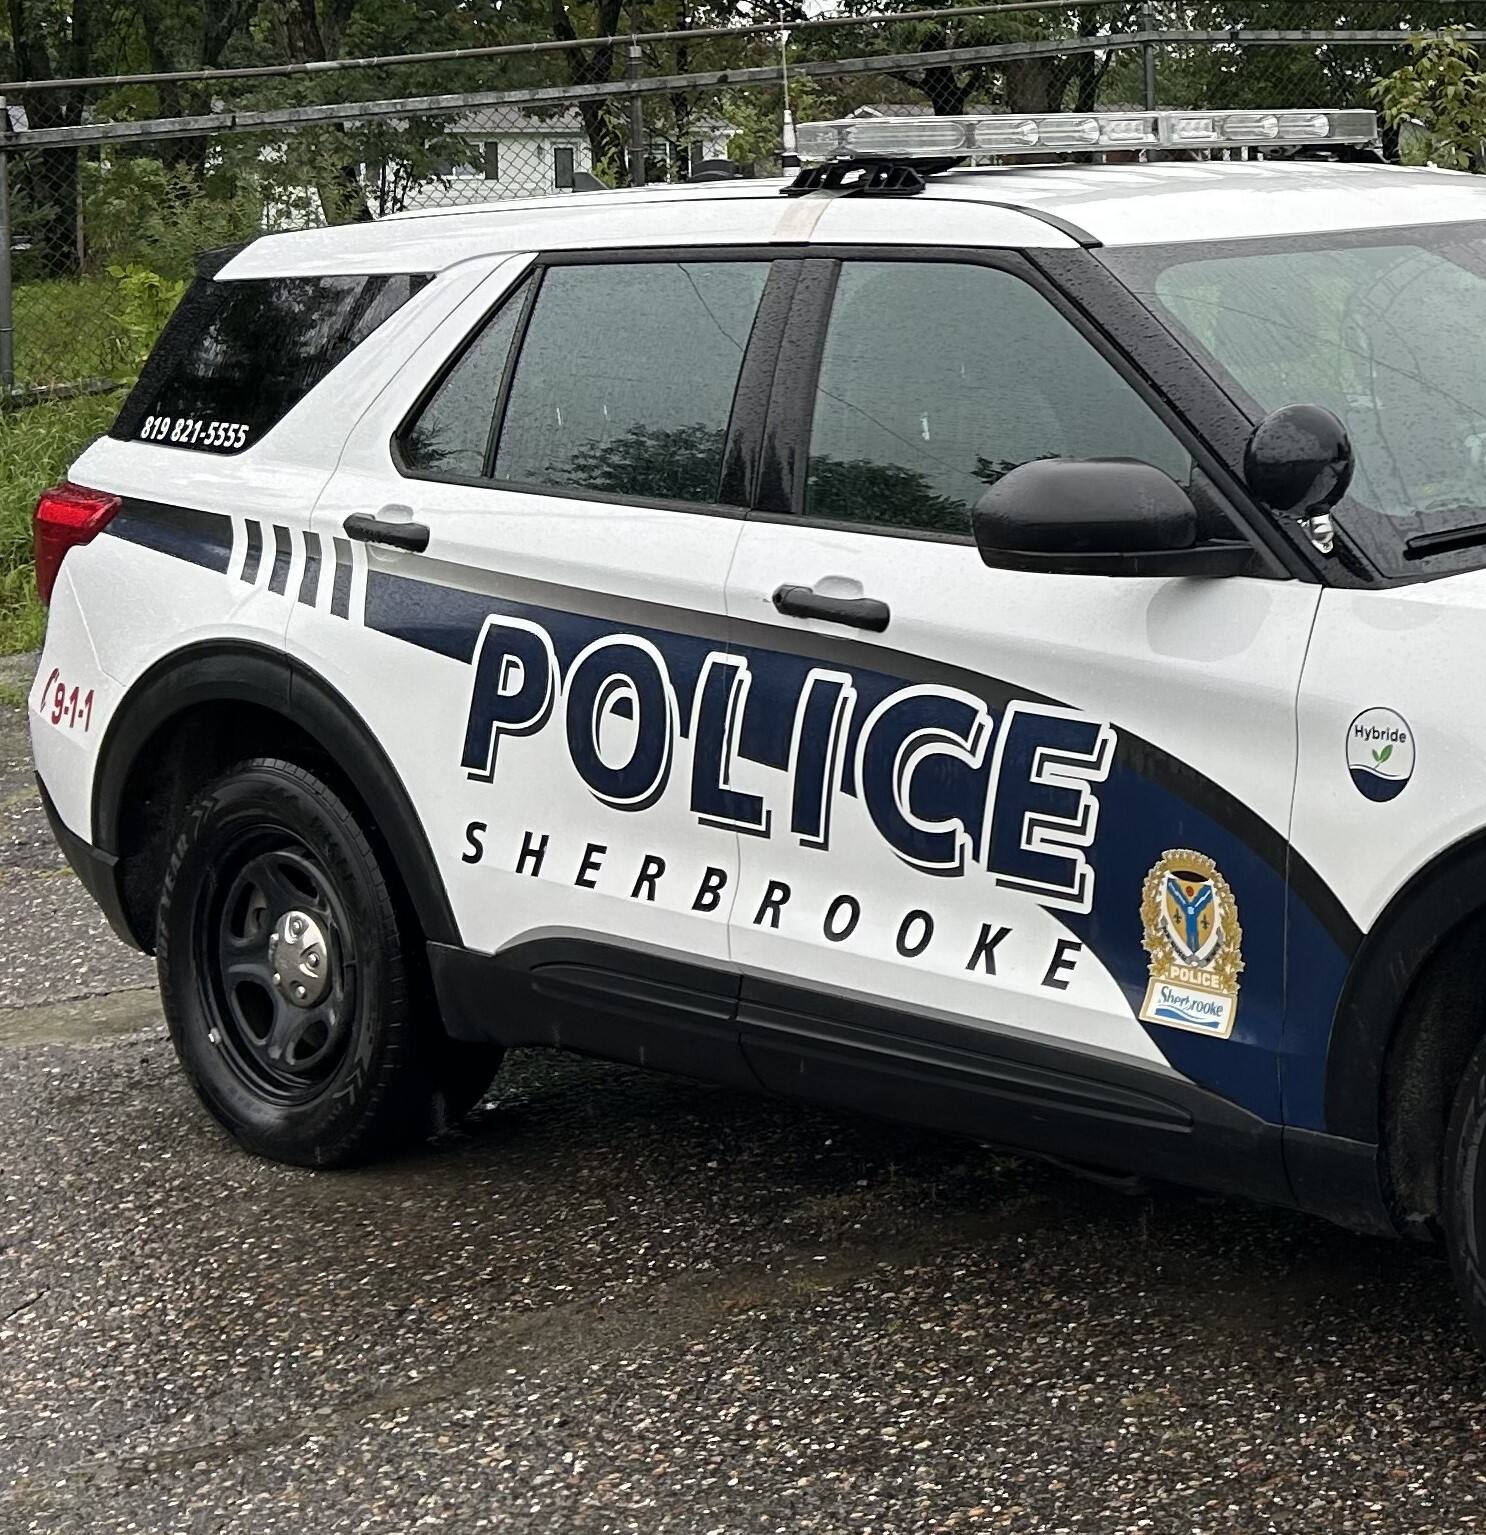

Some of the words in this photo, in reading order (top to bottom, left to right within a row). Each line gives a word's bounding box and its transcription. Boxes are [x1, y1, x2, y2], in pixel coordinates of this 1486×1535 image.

[140, 415, 171, 440] 819
[170, 418, 250, 448] 821-5555
[51, 682, 95, 733] 9-1-1
[1354, 724, 1407, 743] Hybride
[460, 613, 1118, 915] POLICE
[461, 820, 1083, 991] SHERBROOKE
[1169, 965, 1221, 989] POLICE
[1160, 985, 1224, 1017] Sherbrooke
